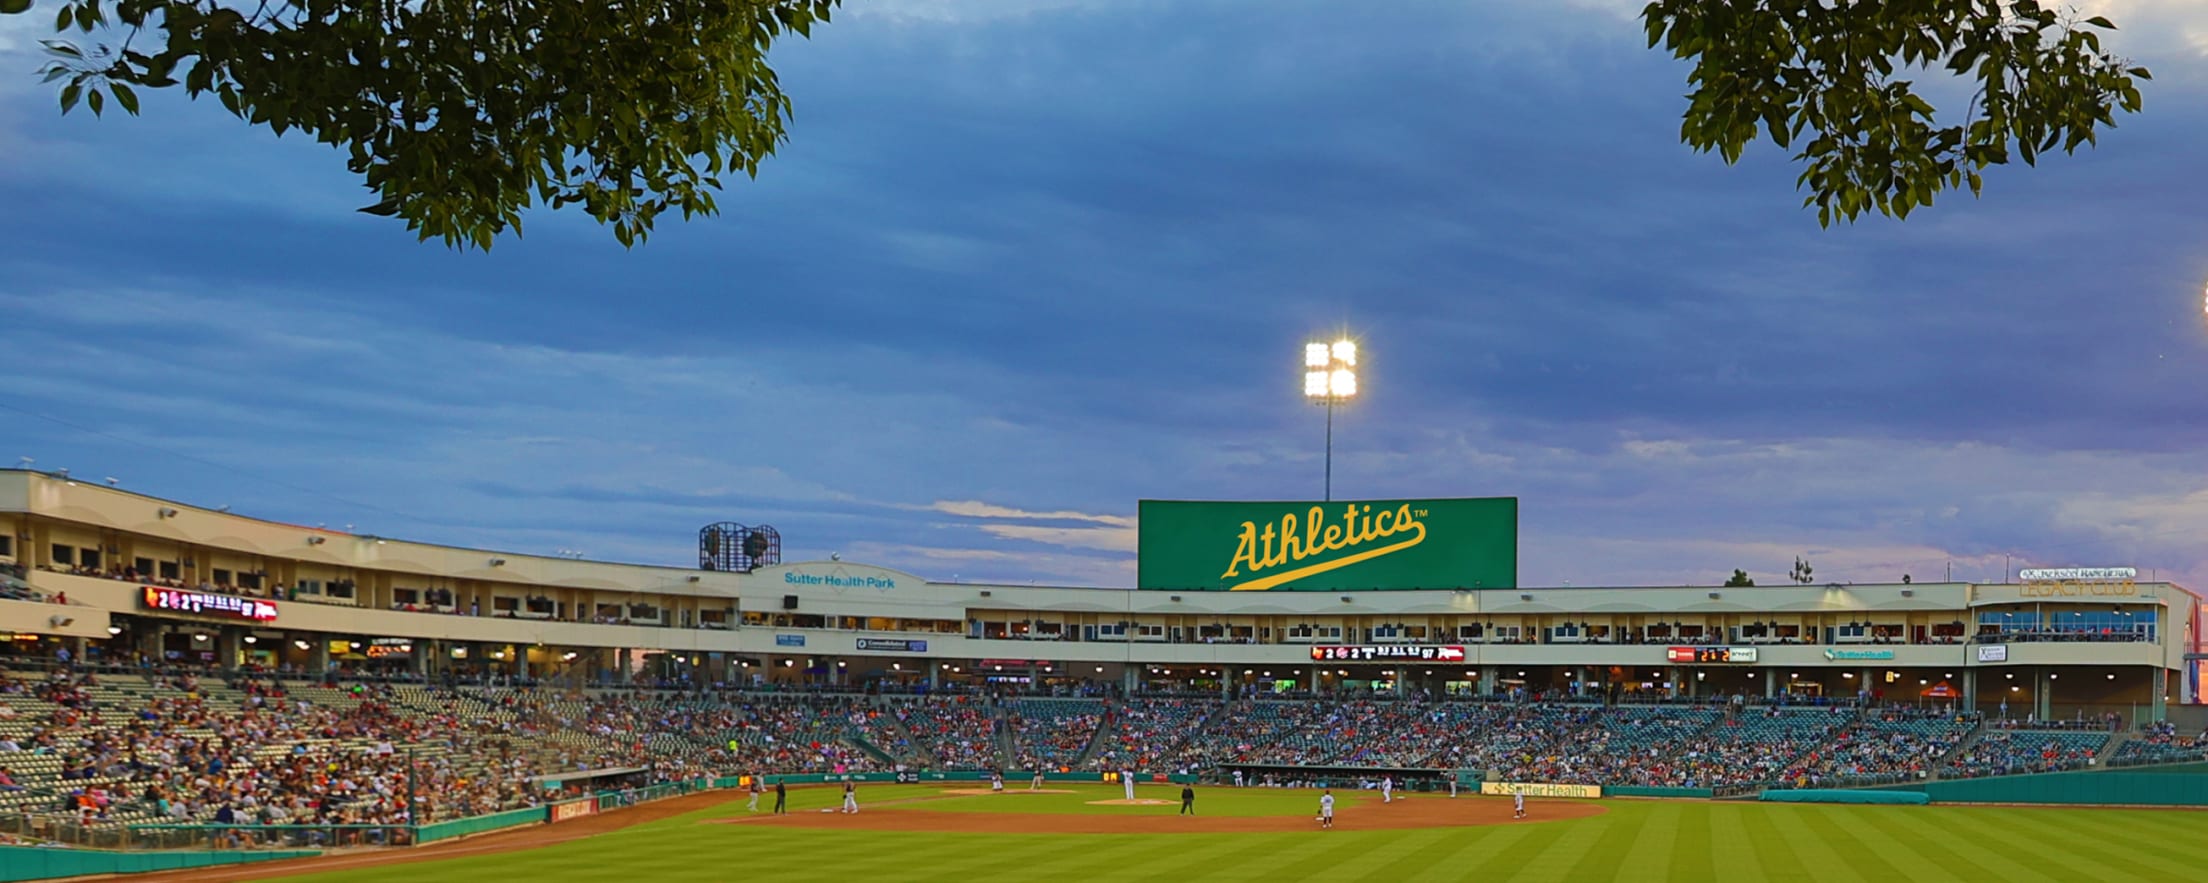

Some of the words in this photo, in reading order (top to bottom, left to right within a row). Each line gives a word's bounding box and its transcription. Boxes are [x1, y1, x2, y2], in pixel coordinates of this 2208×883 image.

[1220, 503, 1414, 580] Athletics
[1414, 509, 1428, 517] TM
[784, 572, 823, 585] Sutter
[825, 575, 865, 587] Health
[866, 576, 895, 588] Park
[2019, 579, 2086, 597] LEGACY
[2090, 578, 2136, 596] CLUB
[159, 591, 169, 608] 2
[181, 593, 190, 610] 2
[1325, 648, 1334, 659] 2
[1351, 648, 1359, 659] 2
[1422, 648, 1434, 659] 97
[1547, 785, 1587, 797] Health
